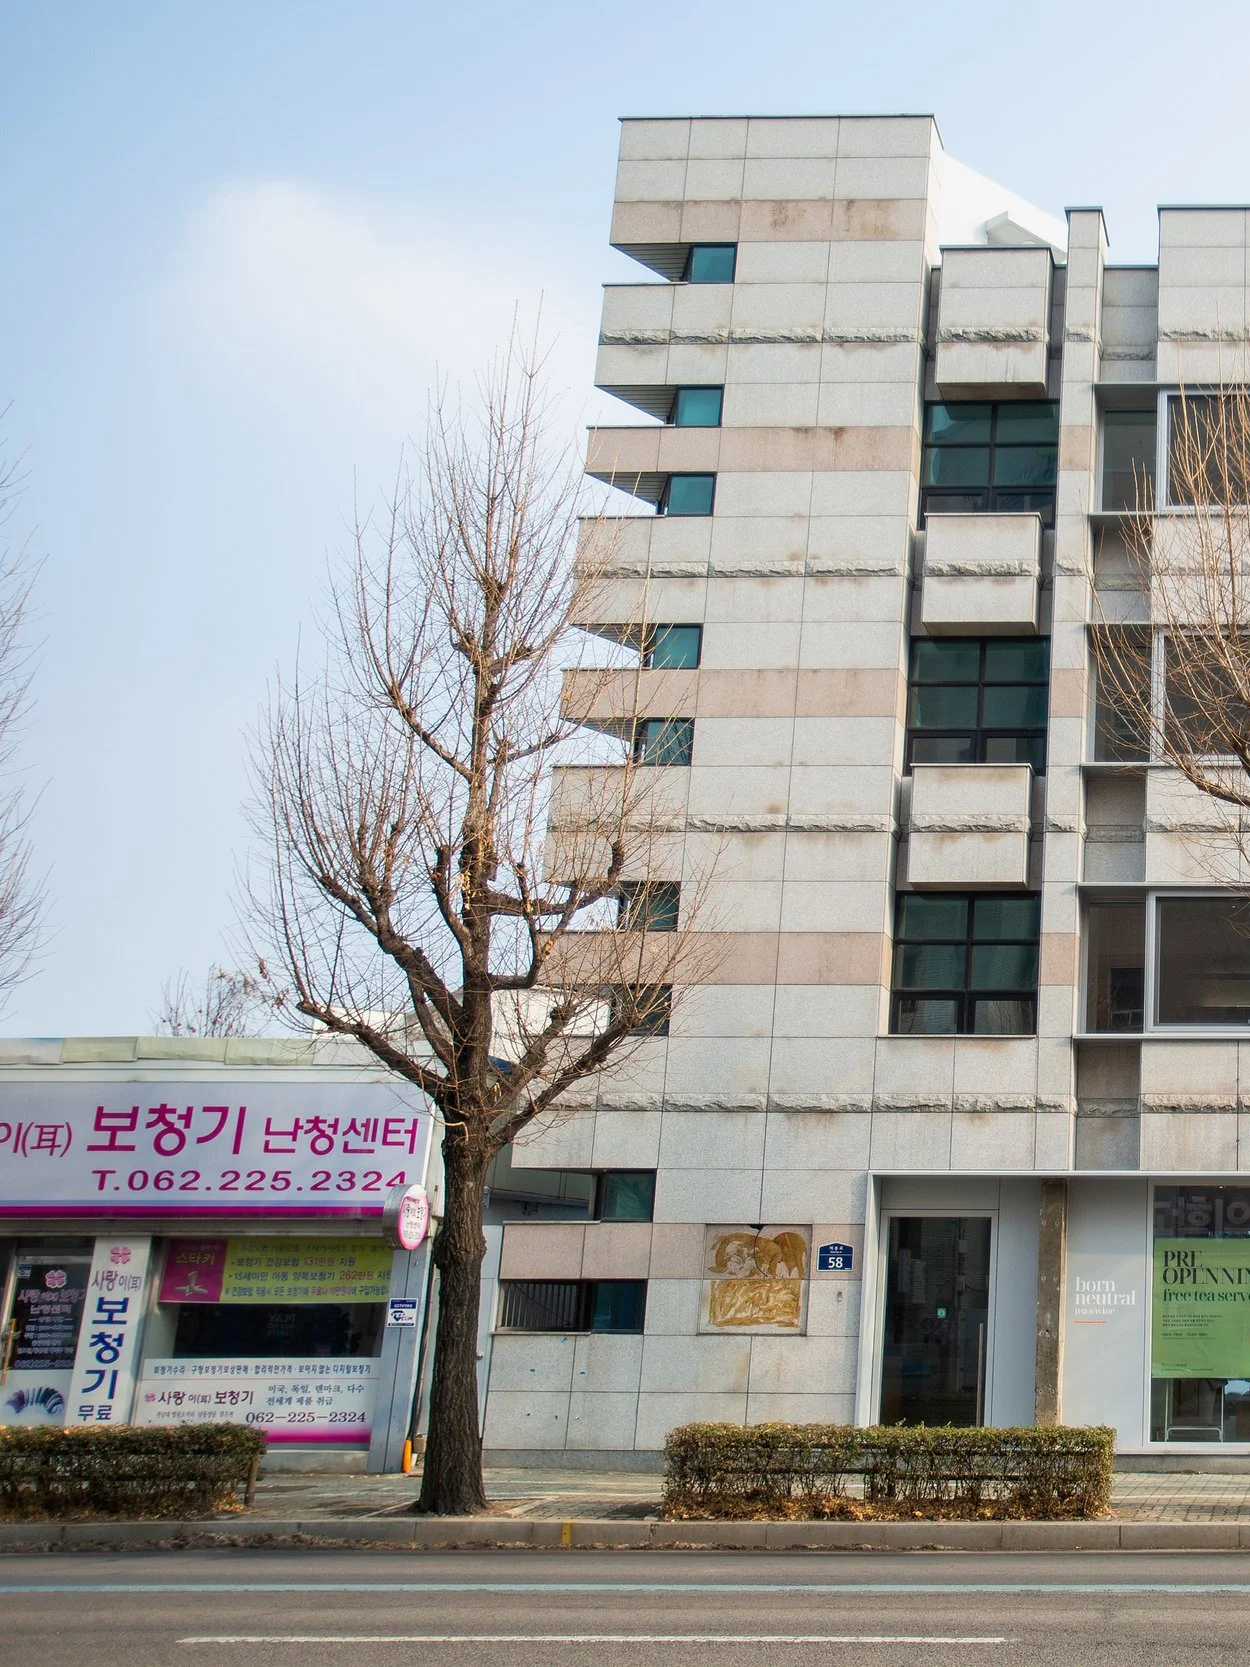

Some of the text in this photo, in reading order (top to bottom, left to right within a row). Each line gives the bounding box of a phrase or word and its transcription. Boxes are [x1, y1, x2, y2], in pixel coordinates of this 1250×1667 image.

[87, 1103, 247, 1157] 보청기
[263, 1115, 418, 1155] 난청센터
[91, 1169, 407, 1192] T.062.225.2324
[828, 1256, 844, 1269] 58
[1163, 1250, 1203, 1268] PRE
[92, 1270, 118, 1292] 사랑
[1075, 1276, 1116, 1292] born
[1074, 1290, 1137, 1305] neutral
[1163, 1288, 1191, 1302] free
[1194, 1290, 1215, 1302] tea
[80, 1296, 130, 1400] 보청기
[158, 1391, 186, 1405] 사랑
[214, 1390, 254, 1405] 보청기
[78, 1405, 112, 1421] 무료
[245, 1411, 367, 1424] 062-225-2324
